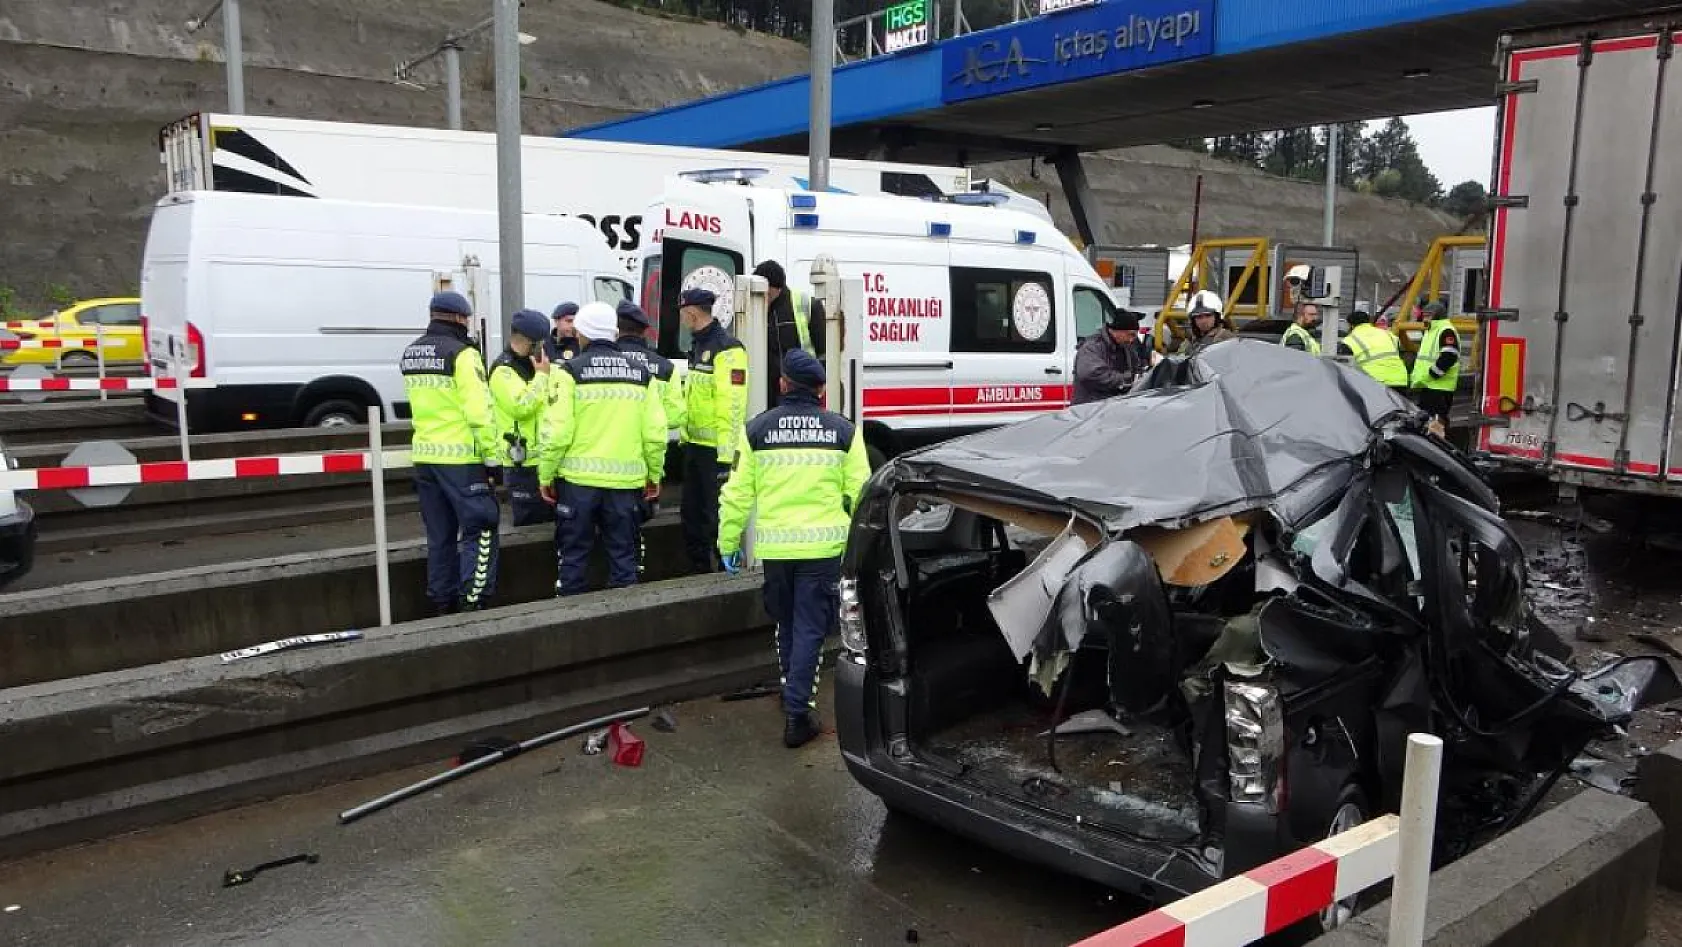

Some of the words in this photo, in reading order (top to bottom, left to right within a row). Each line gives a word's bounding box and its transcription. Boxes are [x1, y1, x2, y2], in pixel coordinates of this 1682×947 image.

[891, 2, 924, 30] HGS
[1054, 30, 1109, 66] içtaş
[1114, 10, 1200, 51] altyapı
[665, 208, 722, 234] LANS
[862, 273, 889, 292] T.C.
[867, 297, 942, 319] BAKANLIĞI
[869, 320, 920, 342] SAĞLIK
[591, 356, 629, 367] OTOYOL
[581, 366, 642, 381] JANDARMASI
[976, 387, 1043, 403] AMBULANS
[778, 417, 823, 429] OTOYOL
[764, 429, 837, 444] JANDARMASI
